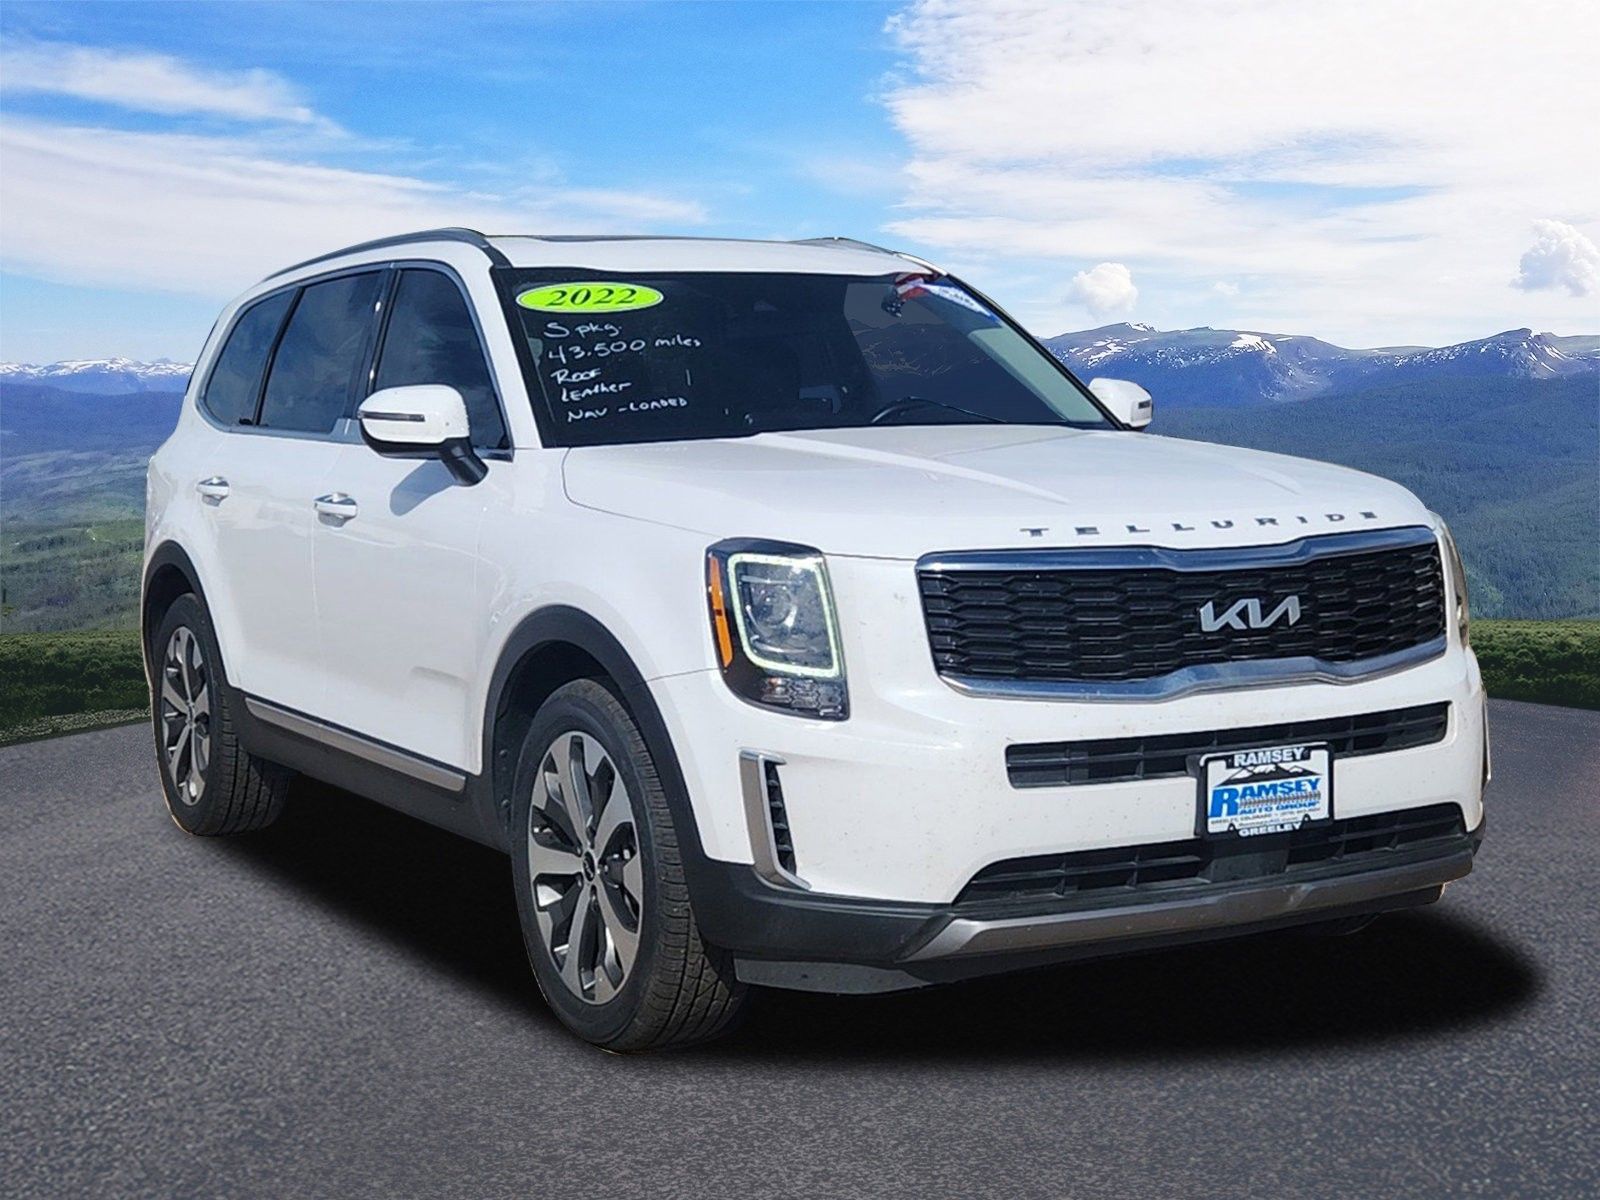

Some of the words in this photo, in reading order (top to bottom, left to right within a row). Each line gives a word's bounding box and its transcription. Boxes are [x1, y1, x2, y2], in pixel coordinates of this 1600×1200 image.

[545, 287, 637, 307] 2022
[543, 322, 570, 338] S
[655, 334, 701, 347] miles
[1020, 510, 1378, 537] TELLURIDE
[1200, 595, 1300, 632] KIA
[1234, 748, 1304, 767] RAMSEY
[1209, 778, 1320, 817] RAMSEY
[1239, 806, 1274, 815] AUTO
[1276, 801, 1320, 811] GROUP
[1239, 823, 1301, 837] GREELEY
